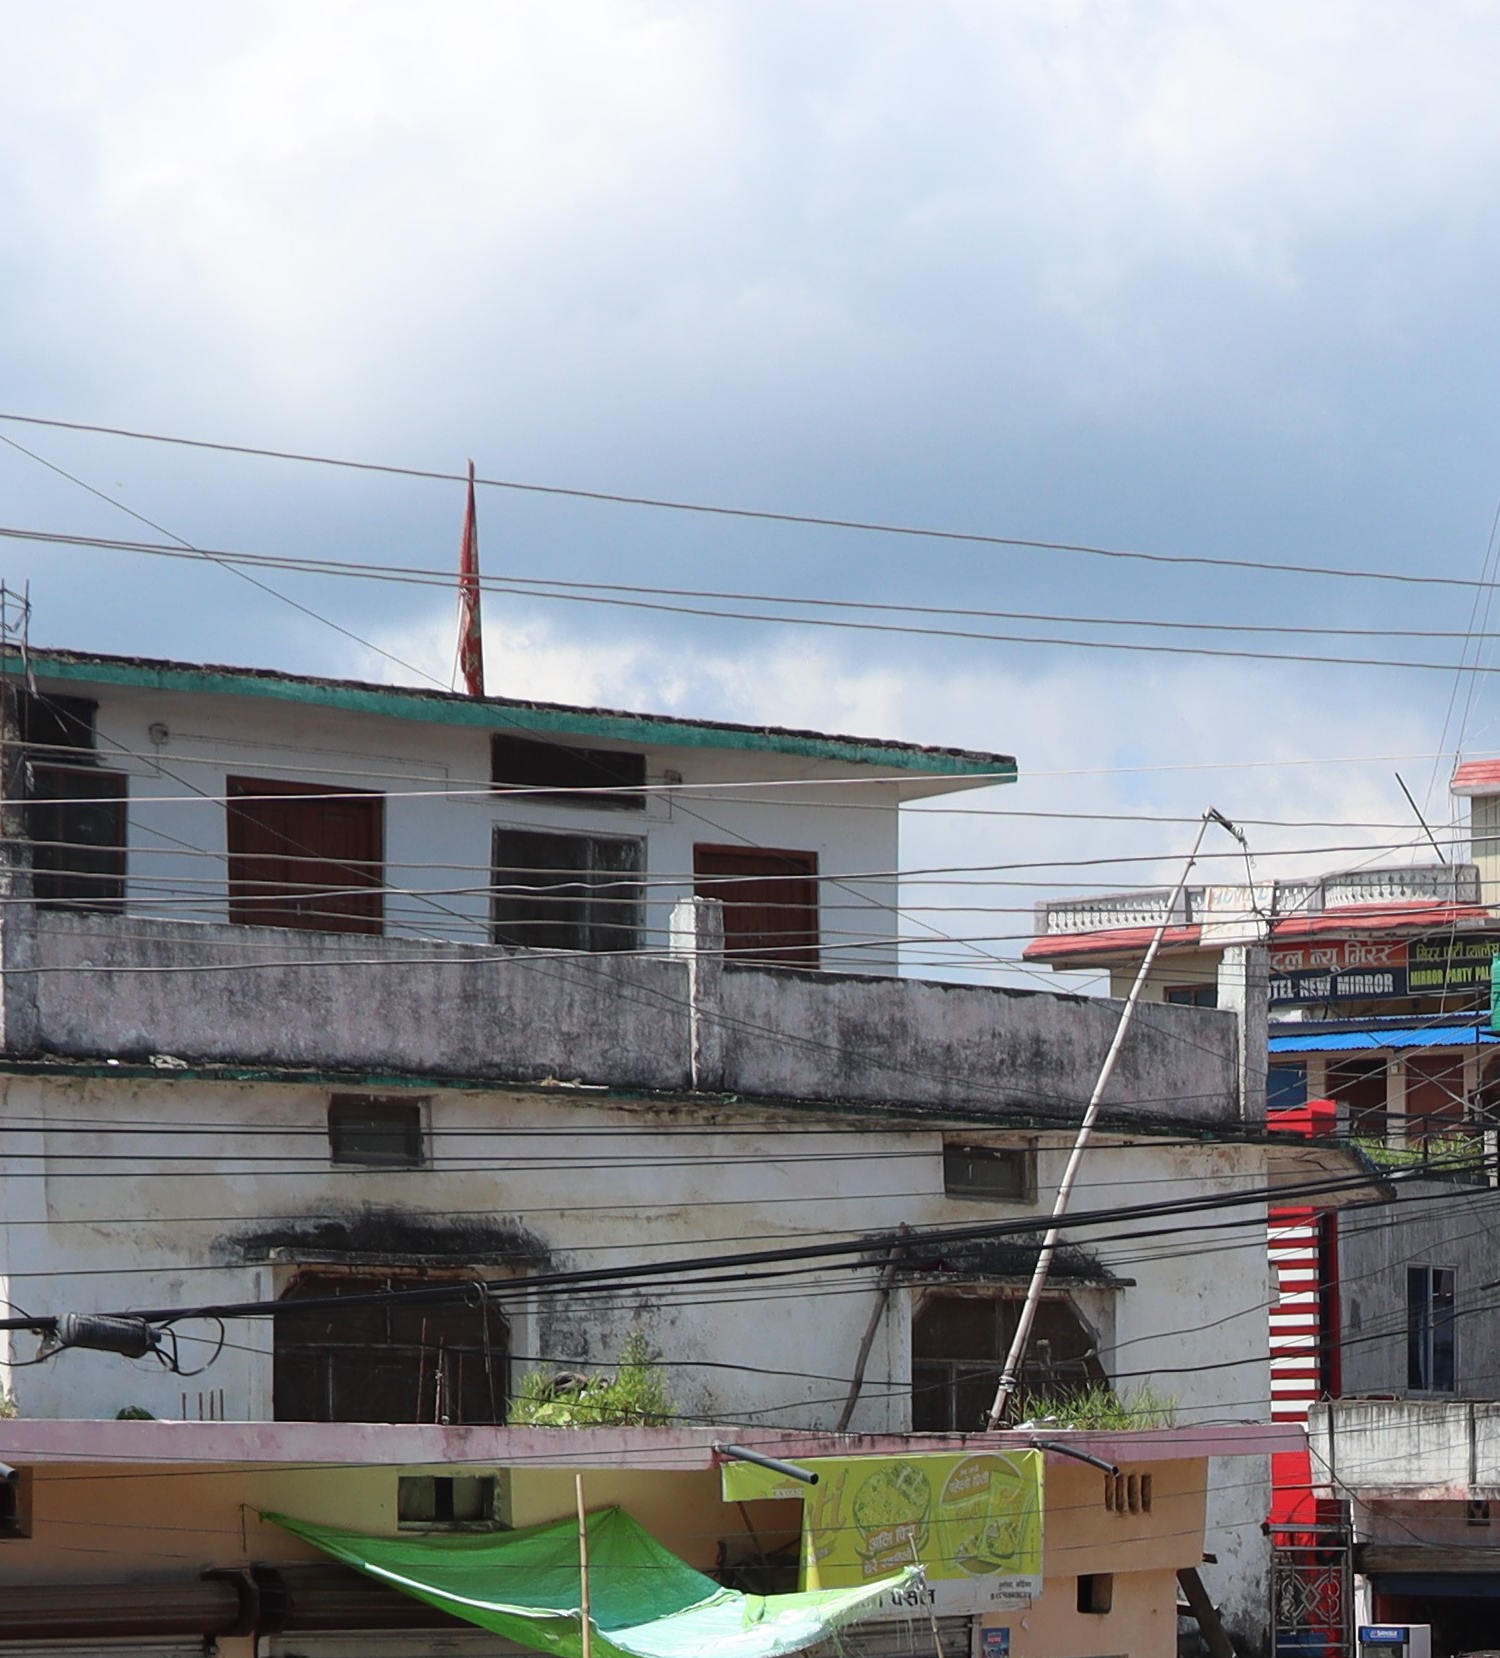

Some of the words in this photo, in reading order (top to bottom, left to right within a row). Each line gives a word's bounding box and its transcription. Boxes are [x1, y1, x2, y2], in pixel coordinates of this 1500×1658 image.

[1300, 977, 1332, 997] NEW
[1337, 973, 1394, 996] MIRROR
[1410, 969, 1443, 986] MIRROR
[1445, 968, 1473, 985] PARTY
